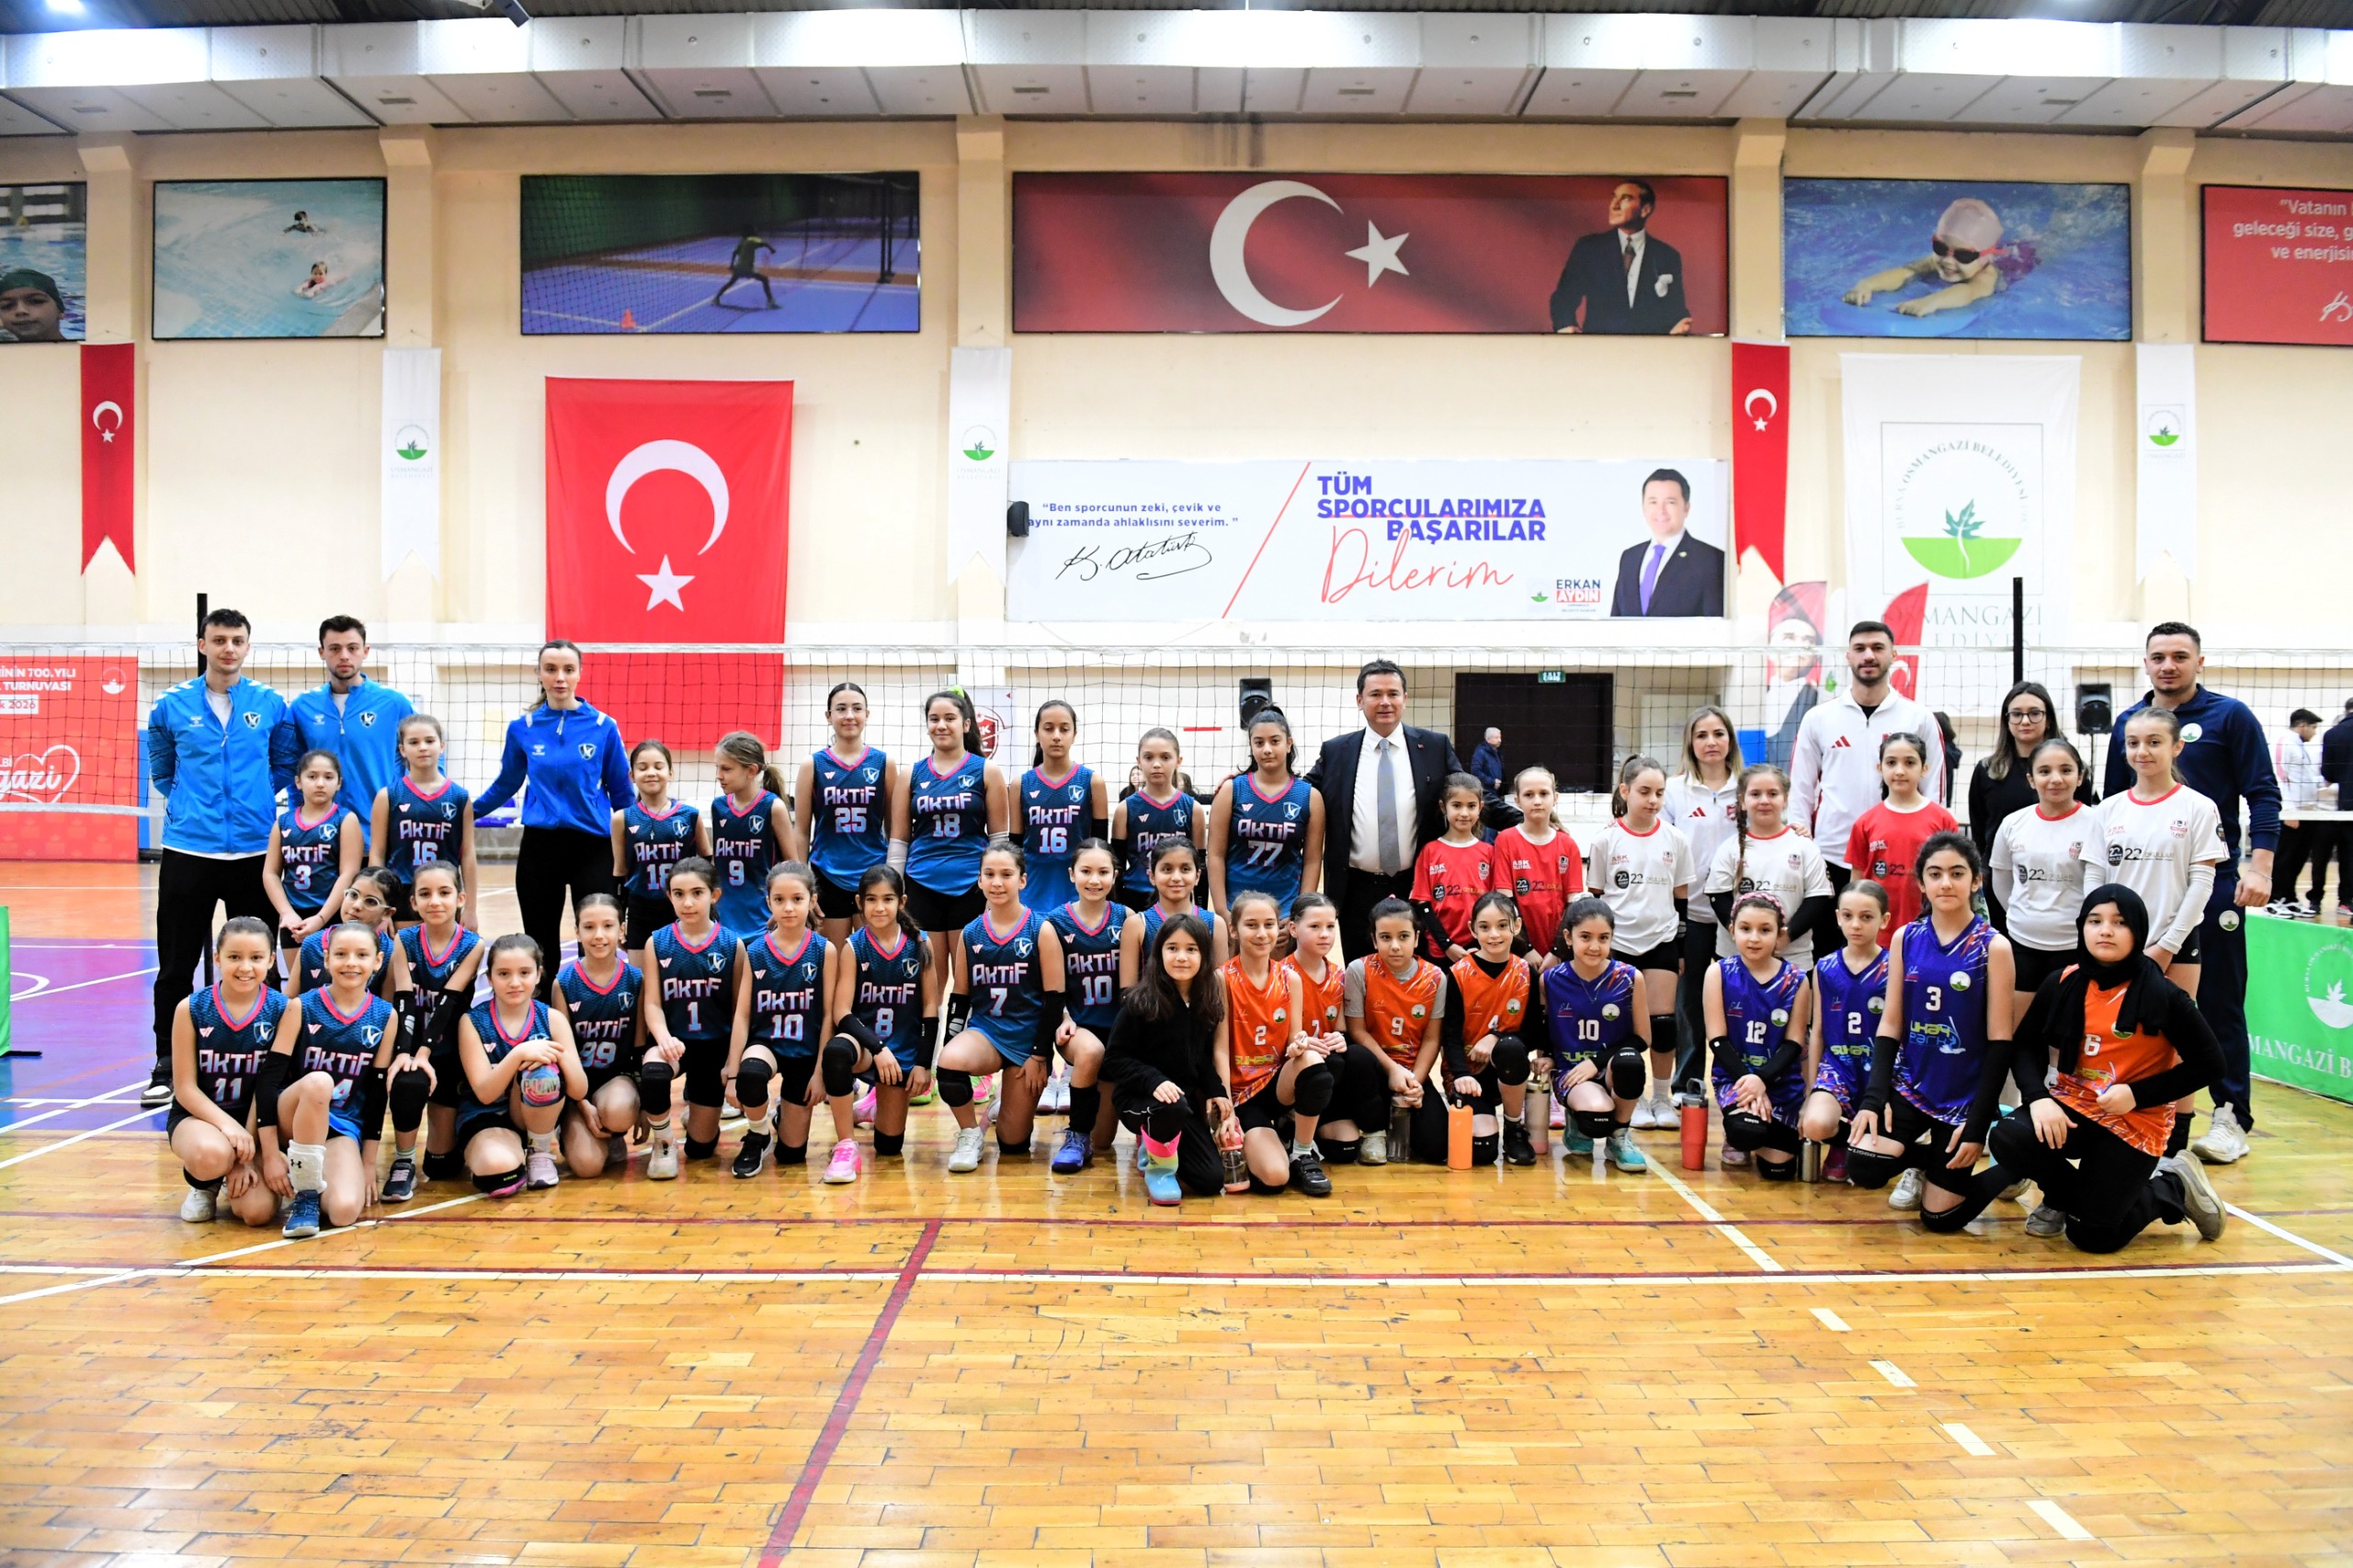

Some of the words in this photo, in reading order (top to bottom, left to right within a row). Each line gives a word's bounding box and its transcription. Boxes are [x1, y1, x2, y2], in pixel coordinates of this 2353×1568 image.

[2233, 221, 2300, 239] geleceği
[2304, 222, 2339, 240] size,
[2271, 247, 2290, 258] ve
[2294, 246, 2353, 263] enerjisi
[1902, 439, 1970, 483] OSMANGAZİ
[1317, 471, 1372, 495] TÜM
[1042, 503, 1072, 512] “Ben
[1075, 504, 1137, 514] sporcunun
[1141, 503, 1168, 514] zeki,
[1172, 503, 1203, 515] çevik
[1317, 498, 1546, 519] SPORCULARIMIZA
[1029, 519, 1053, 529] aynı
[1057, 517, 1110, 527] zamanda
[1113, 517, 1175, 527] ahlaklısını
[1177, 517, 1229, 527] severim.
[1387, 520, 1546, 544] BAŞARILAR
[1321, 525, 1514, 604] Dilerim
[1556, 579, 1600, 589] ERKAN
[1557, 590, 1600, 602] AYDIN
[0, 666, 25, 677] İNİN
[4, 680, 72, 691] TURNUVASI
[8, 700, 36, 710] 2026
[835, 807, 868, 834] 25
[932, 812, 961, 838] 18
[1039, 826, 1068, 854] 16
[412, 840, 439, 866] 16
[1247, 840, 1283, 867] 77
[2124, 847, 2143, 860] 22
[293, 864, 312, 891] 3
[729, 859, 745, 887] 9
[1631, 873, 1643, 884] 22
[2029, 869, 2047, 881] 22
[1756, 881, 1771, 891] 22
[989, 987, 1008, 1017] 7
[1082, 975, 1112, 1006] 10
[1925, 985, 1941, 1011] 3
[687, 1001, 702, 1031] 1
[770, 1014, 804, 1041] 10
[875, 1007, 894, 1038] 8
[1391, 1017, 1404, 1036] 9
[1487, 1014, 1499, 1030] 4
[1847, 1012, 1862, 1034] 2
[1255, 1025, 1267, 1046] 2
[1577, 1018, 1599, 1041] 10
[1745, 1019, 1767, 1045] 12
[2084, 1033, 2102, 1056] 6
[2248, 1033, 2335, 1074] MANGAZİ
[214, 1077, 243, 1104] 11
[331, 1078, 354, 1108] 4
